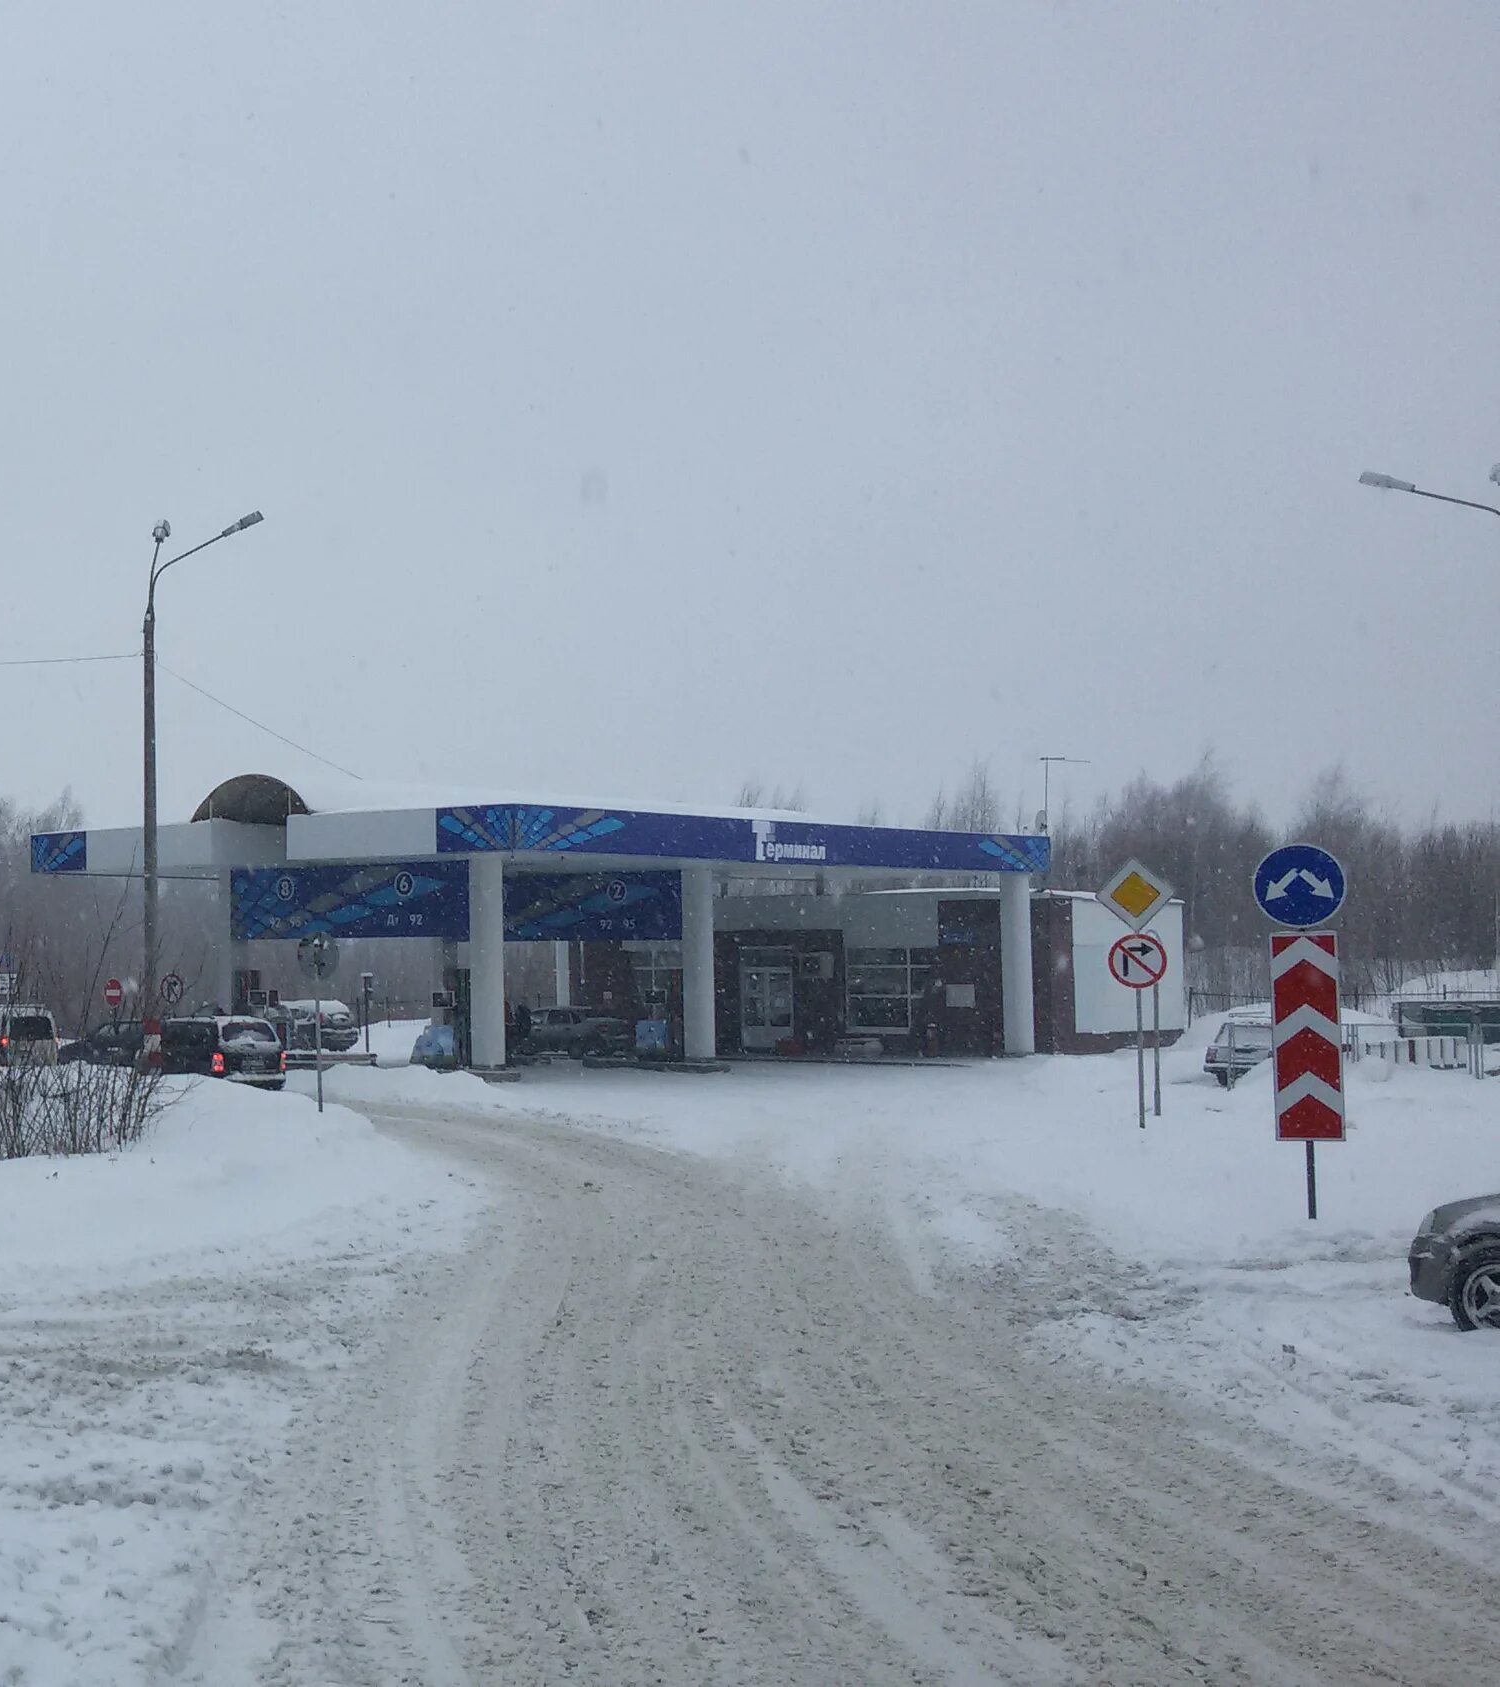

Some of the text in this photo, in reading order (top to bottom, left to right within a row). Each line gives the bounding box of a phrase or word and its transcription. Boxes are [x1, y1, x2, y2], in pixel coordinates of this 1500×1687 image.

[752, 820, 827, 862] Терминал
[280, 879, 290, 897] 8
[399, 875, 409, 892] 6
[612, 884, 622, 899] 2
[409, 913, 423, 926] 92
[599, 918, 636, 930] 92 95
